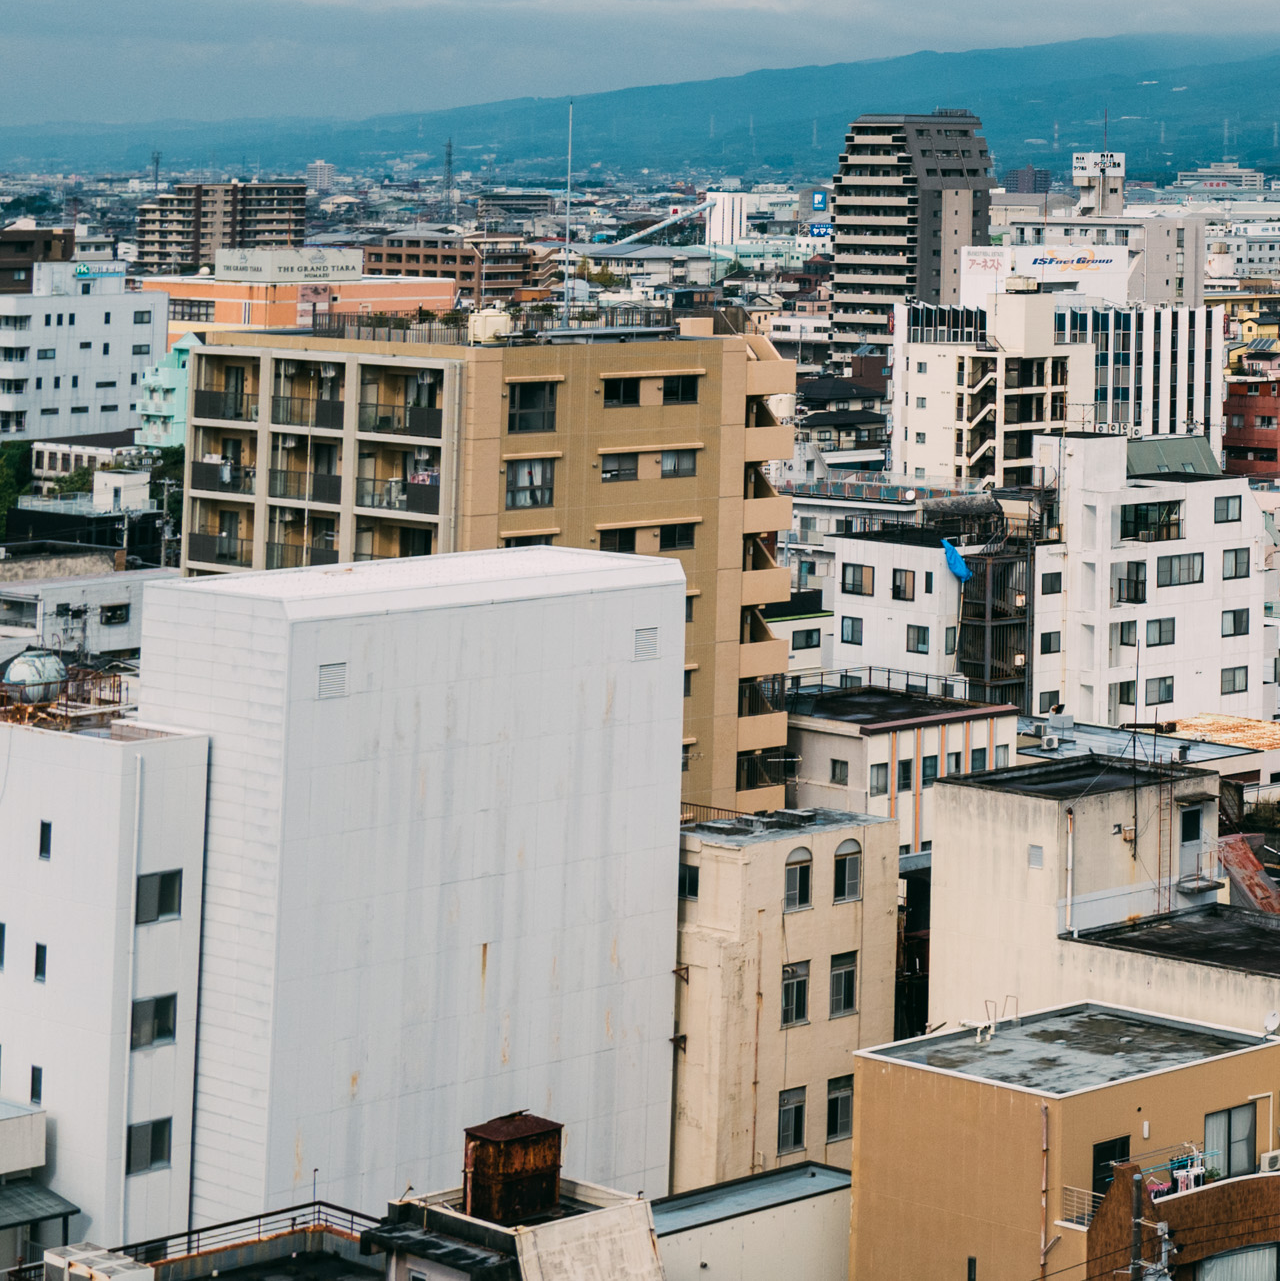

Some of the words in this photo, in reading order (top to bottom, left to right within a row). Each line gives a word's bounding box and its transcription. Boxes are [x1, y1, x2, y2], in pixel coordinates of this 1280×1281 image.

[968, 258, 1002, 270] アーネスト
[1076, 257, 1113, 265] Group
